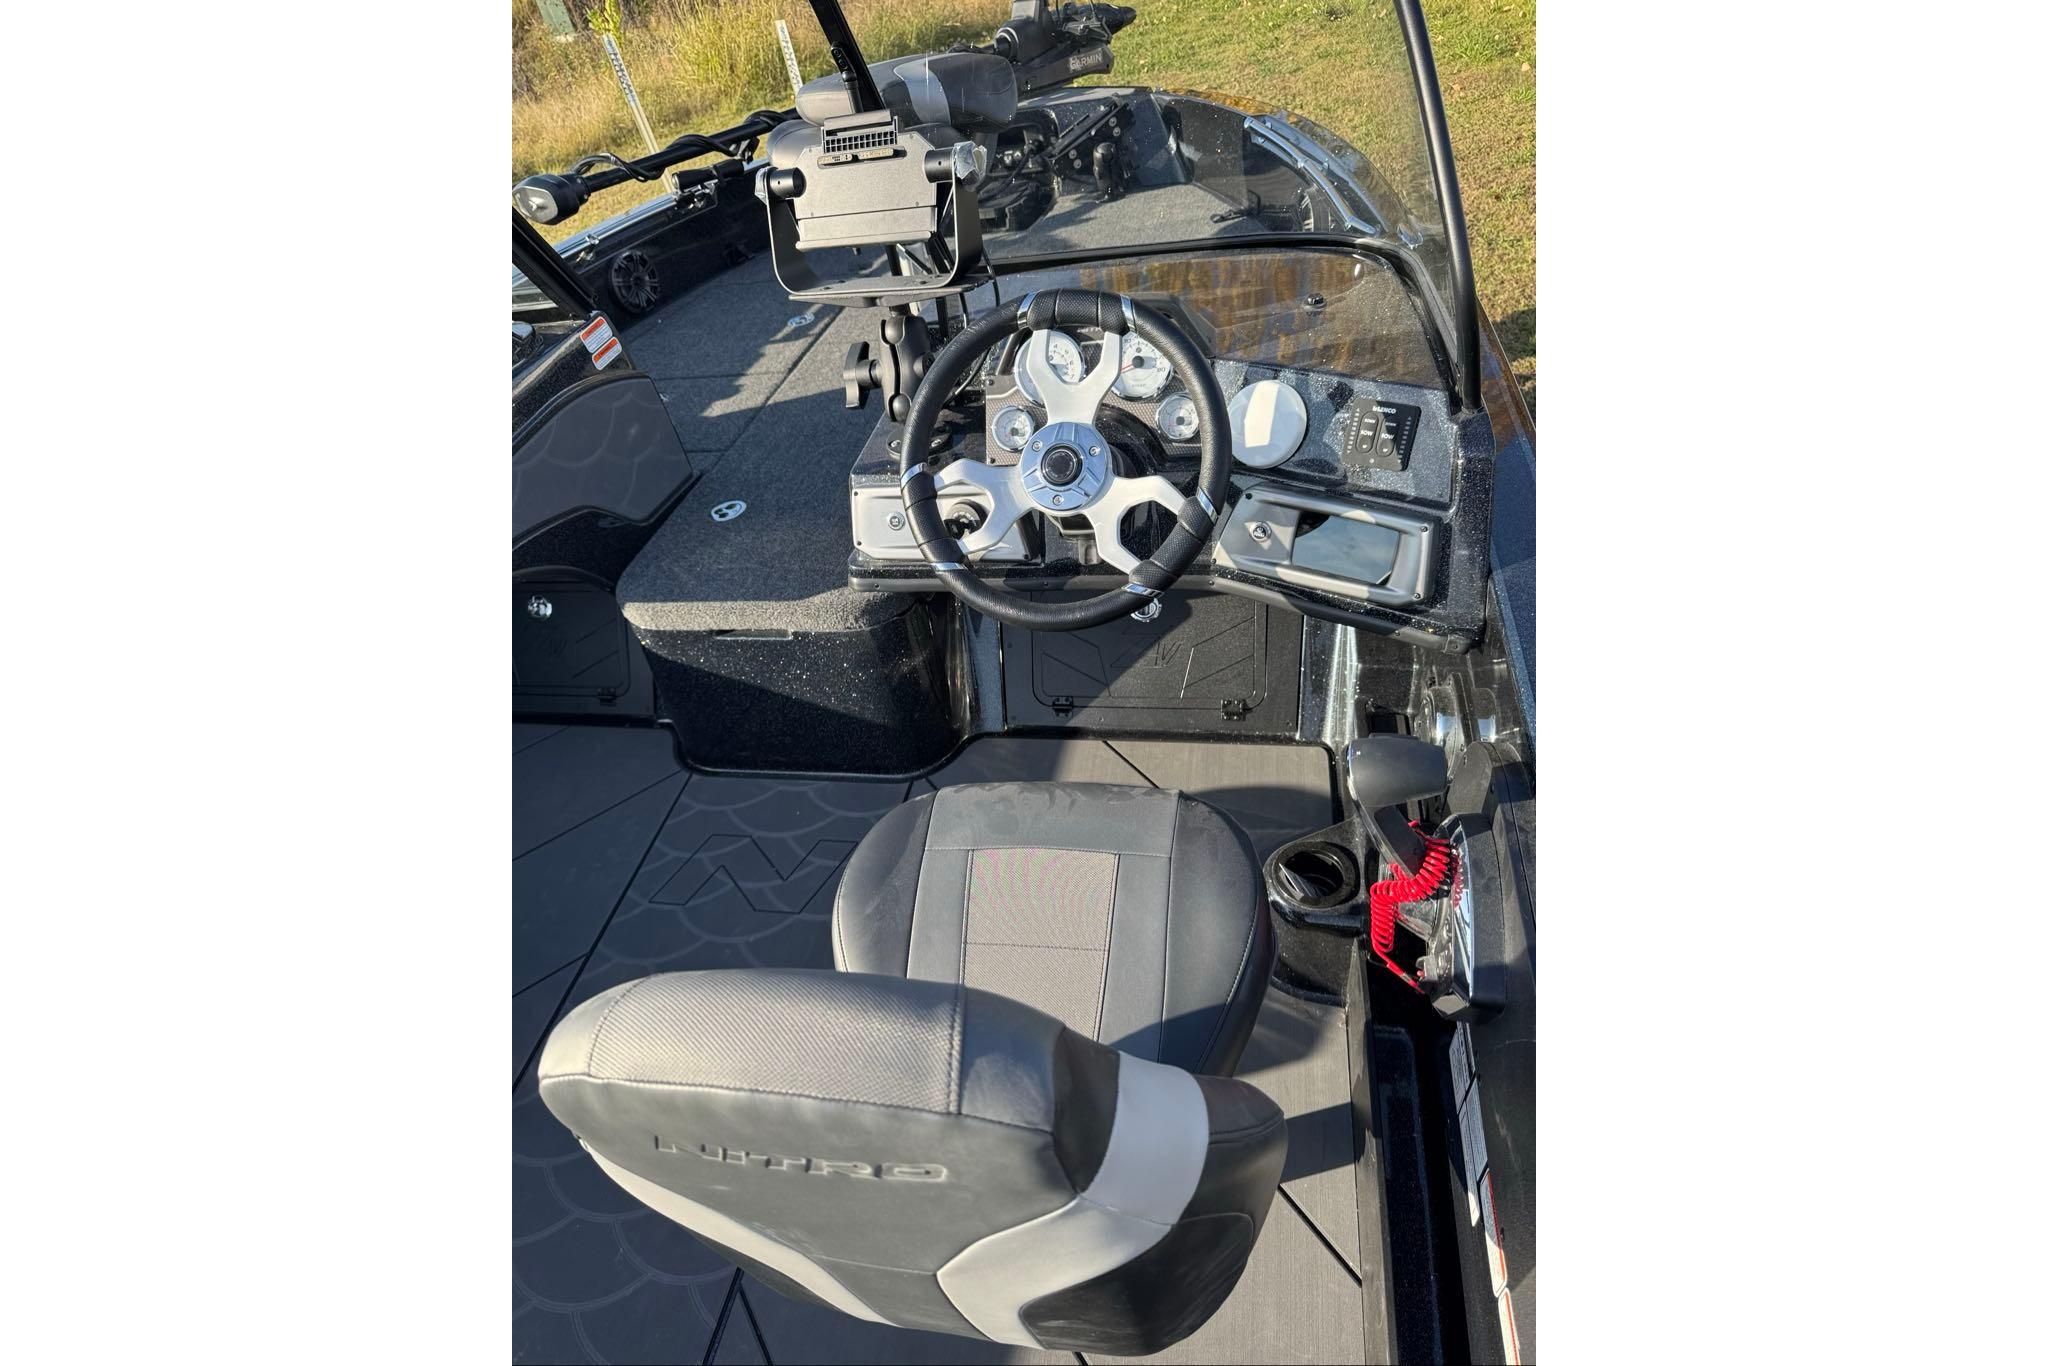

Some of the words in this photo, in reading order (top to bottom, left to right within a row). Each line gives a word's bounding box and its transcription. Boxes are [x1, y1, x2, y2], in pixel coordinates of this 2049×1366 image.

[1070, 51, 1103, 70] GARMIN
[1377, 406, 1397, 414] LENCO
[654, 1134, 948, 1182] NITRO
